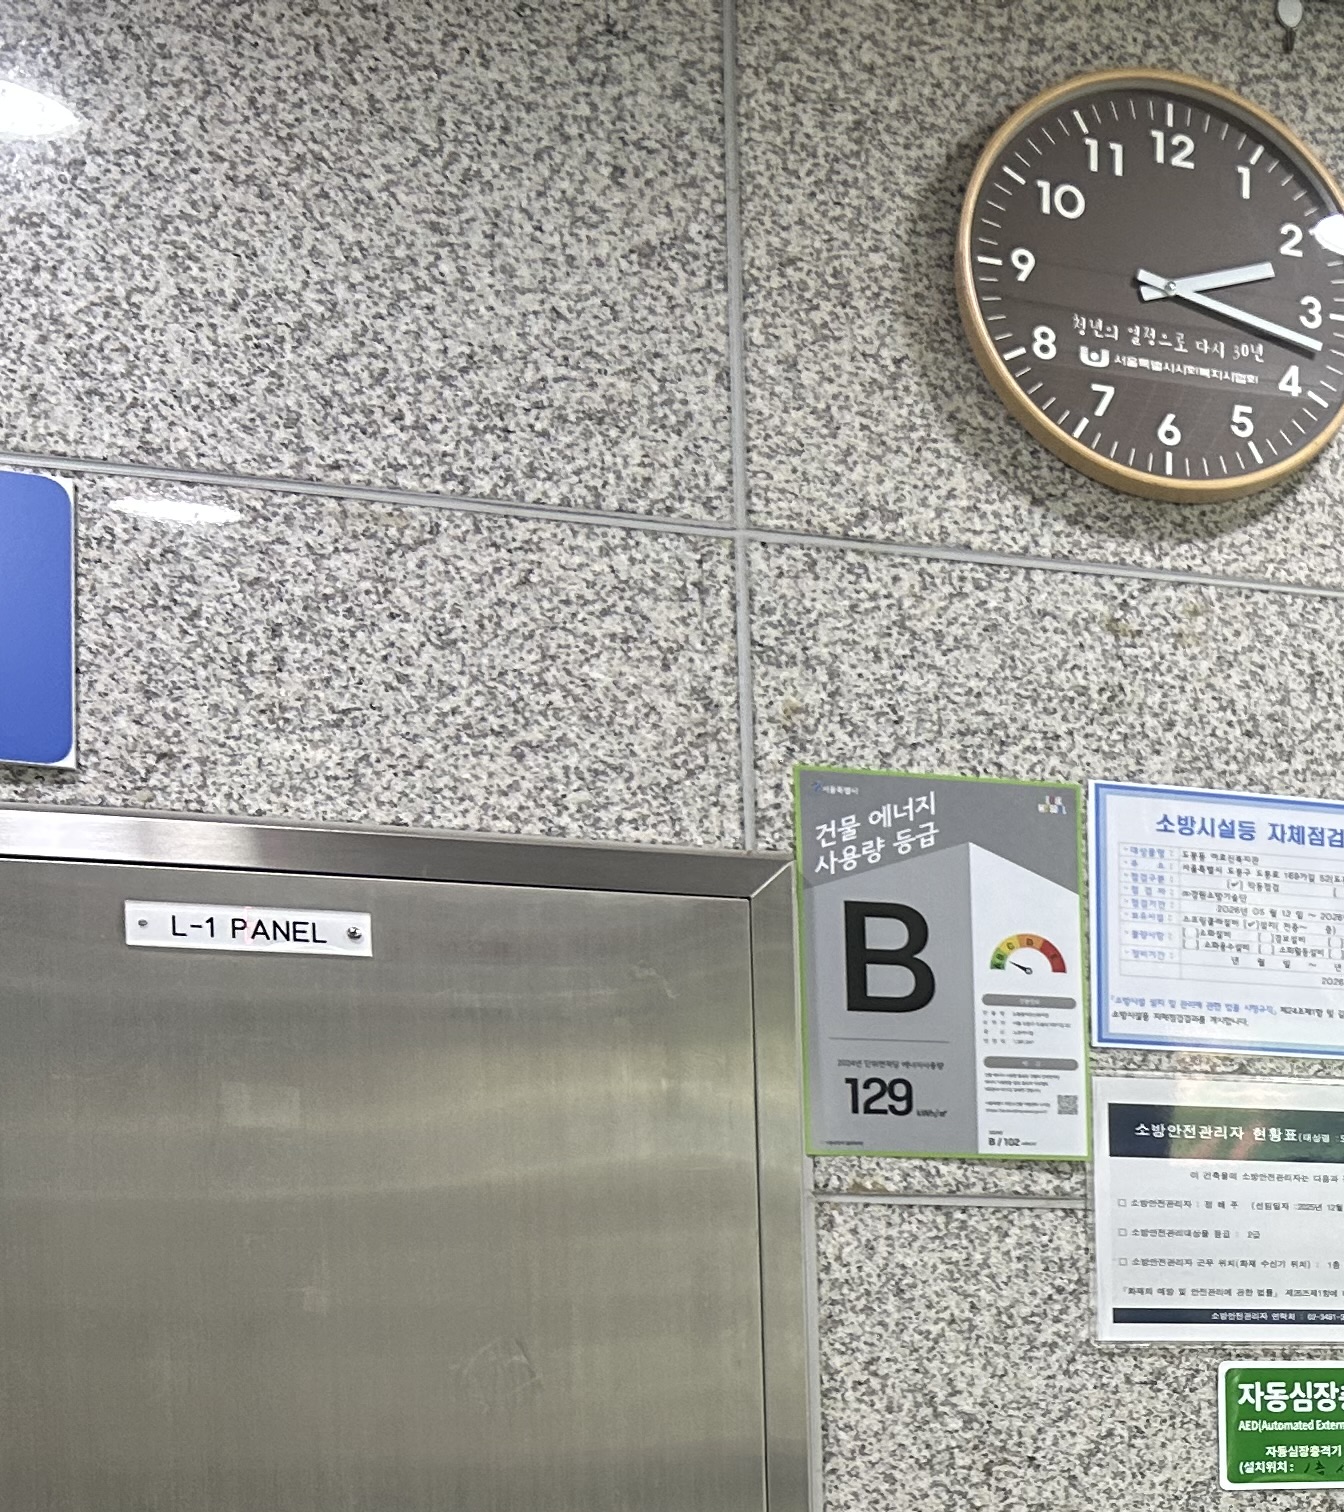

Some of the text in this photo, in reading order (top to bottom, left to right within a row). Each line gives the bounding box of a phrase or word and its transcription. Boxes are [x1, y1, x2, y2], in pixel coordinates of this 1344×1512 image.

[1085, 138, 1123, 176] 11
[1152, 129, 1195, 169] 12
[1237, 166, 1251, 199] 1
[1037, 180, 1085, 219] 10
[1280, 223, 1303, 257] 2
[1011, 248, 1035, 281] 9
[1299, 296, 1322, 328] 3
[1033, 326, 1056, 360] 8
[1072, 313, 1264, 363] 청년의 열정으로 다시 30년
[1278, 365, 1302, 396] 4
[1091, 384, 1115, 416] 7
[1157, 413, 1181, 446] 6
[1231, 405, 1253, 437] 5
[815, 790, 936, 848] 건물 에너지
[1155, 813, 1257, 841] 소방시설등
[814, 821, 940, 875] 사용량 등급
[172, 915, 327, 944] L-1 PANEL
[844, 901, 935, 1013] B
[845, 1077, 913, 1116] 129
[1134, 1123, 1244, 1140] 소방안전관리자
[1238, 1419, 1314, 1433] AED(Automated
[1265, 1444, 1342, 1458] 자동심장충격기
